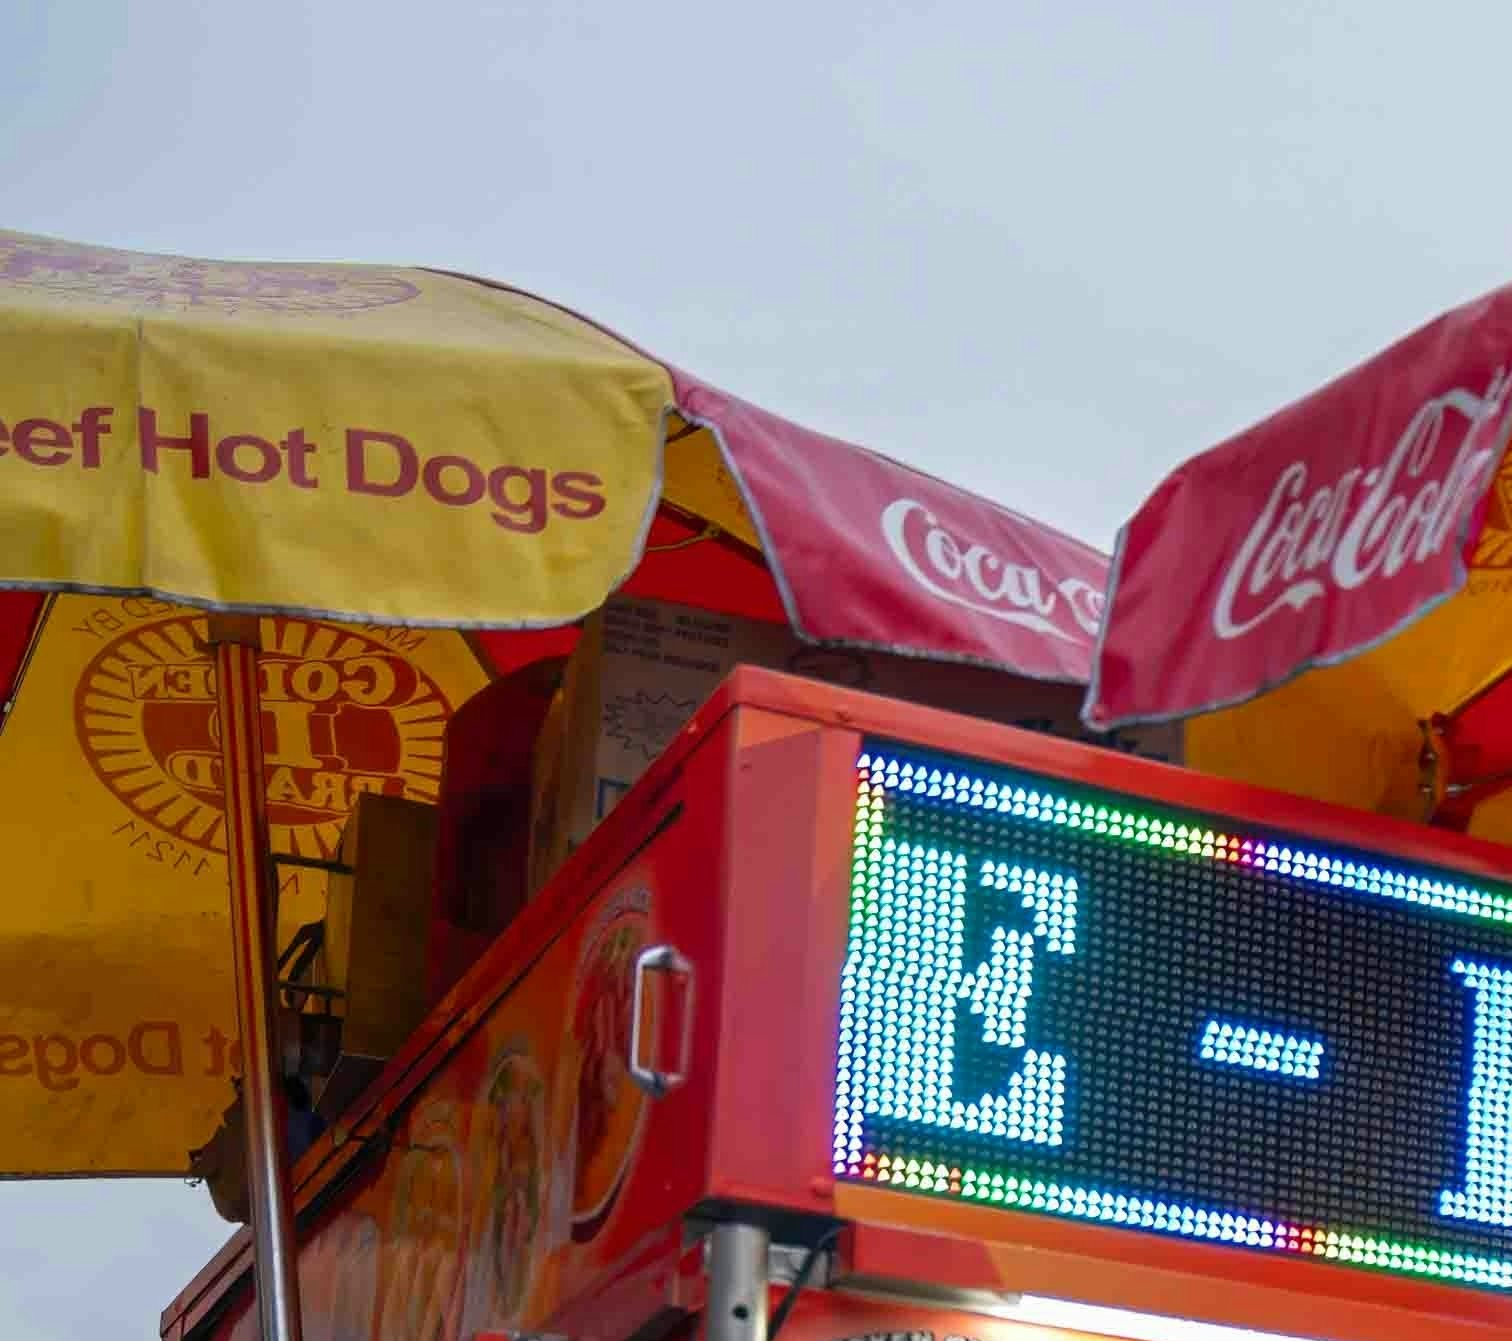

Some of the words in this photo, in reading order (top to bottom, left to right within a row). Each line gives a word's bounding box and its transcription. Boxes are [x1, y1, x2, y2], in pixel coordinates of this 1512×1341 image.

[0, 404, 113, 474] ef
[139, 406, 319, 490] Hot
[347, 428, 608, 535] Dogs
